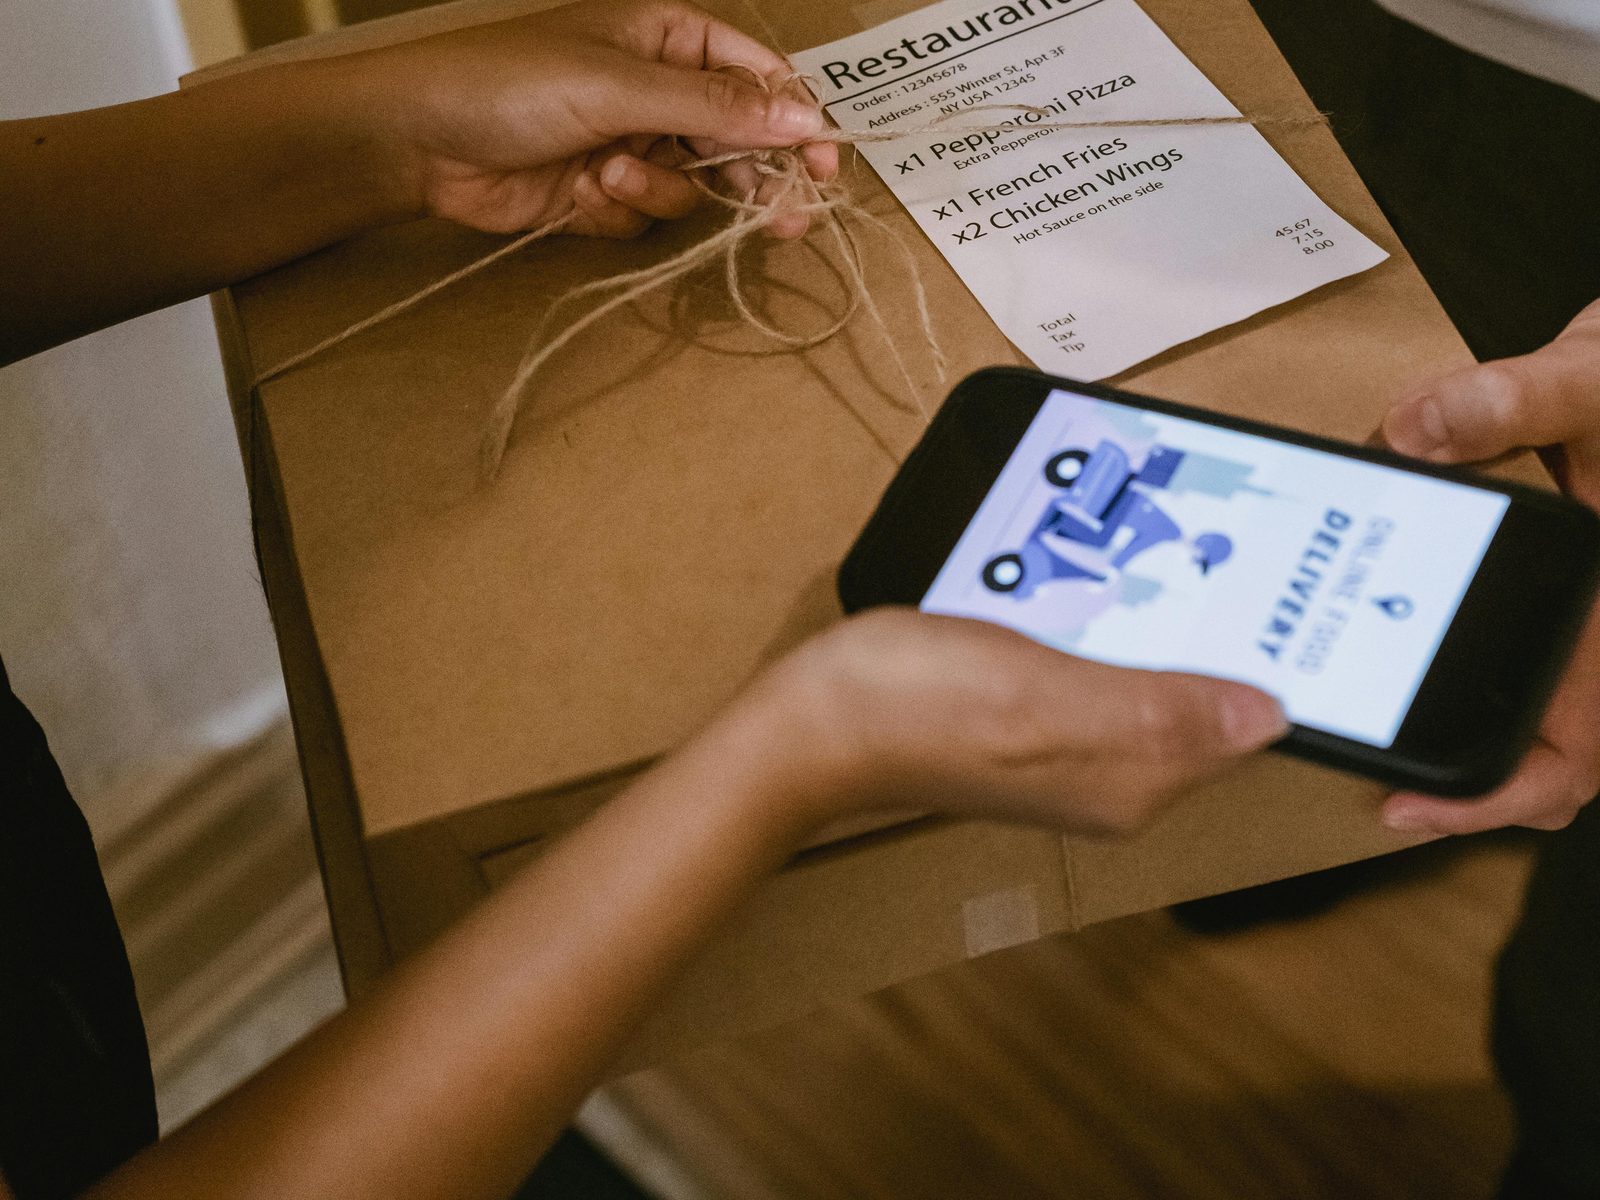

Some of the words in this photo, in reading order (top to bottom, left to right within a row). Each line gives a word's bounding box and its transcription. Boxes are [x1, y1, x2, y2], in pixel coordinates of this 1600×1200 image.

[852, 92, 892, 111] Order
[901, 63, 967, 93] 12345678
[868, 104, 922, 128] Address
[930, 89, 956, 104] 555
[955, 70, 1002, 93] Winter
[1003, 64, 1023, 76] St,
[1024, 53, 1049, 68] Apt
[1049, 45, 1066, 58] 3F
[940, 101, 960, 114] NY
[962, 90, 993, 106] USA
[994, 73, 1036, 93] 12345
[893, 152, 926, 175] x1
[1067, 74, 1137, 106] Pizza
[932, 198, 964, 221] x1
[967, 162, 1063, 206] French
[1062, 137, 1128, 170] Fries
[953, 151, 991, 170] Extra
[952, 221, 988, 245] x2
[989, 180, 1099, 229] Chicken
[1096, 148, 1184, 188] Wings
[1013, 228, 1043, 244] Hot
[1042, 210, 1086, 233] Sauce
[1087, 203, 1107, 216] on
[1108, 191, 1133, 207] the
[1134, 179, 1165, 198] side
[1275, 218, 1311, 237] 45.67
[1292, 228, 1324, 245] 7.15
[1302, 239, 1335, 255] 8.00
[1037, 313, 1076, 332] Total
[1048, 330, 1076, 343] Tax
[1059, 342, 1086, 353] Tip
[1258, 507, 1352, 662] DELIVERY
